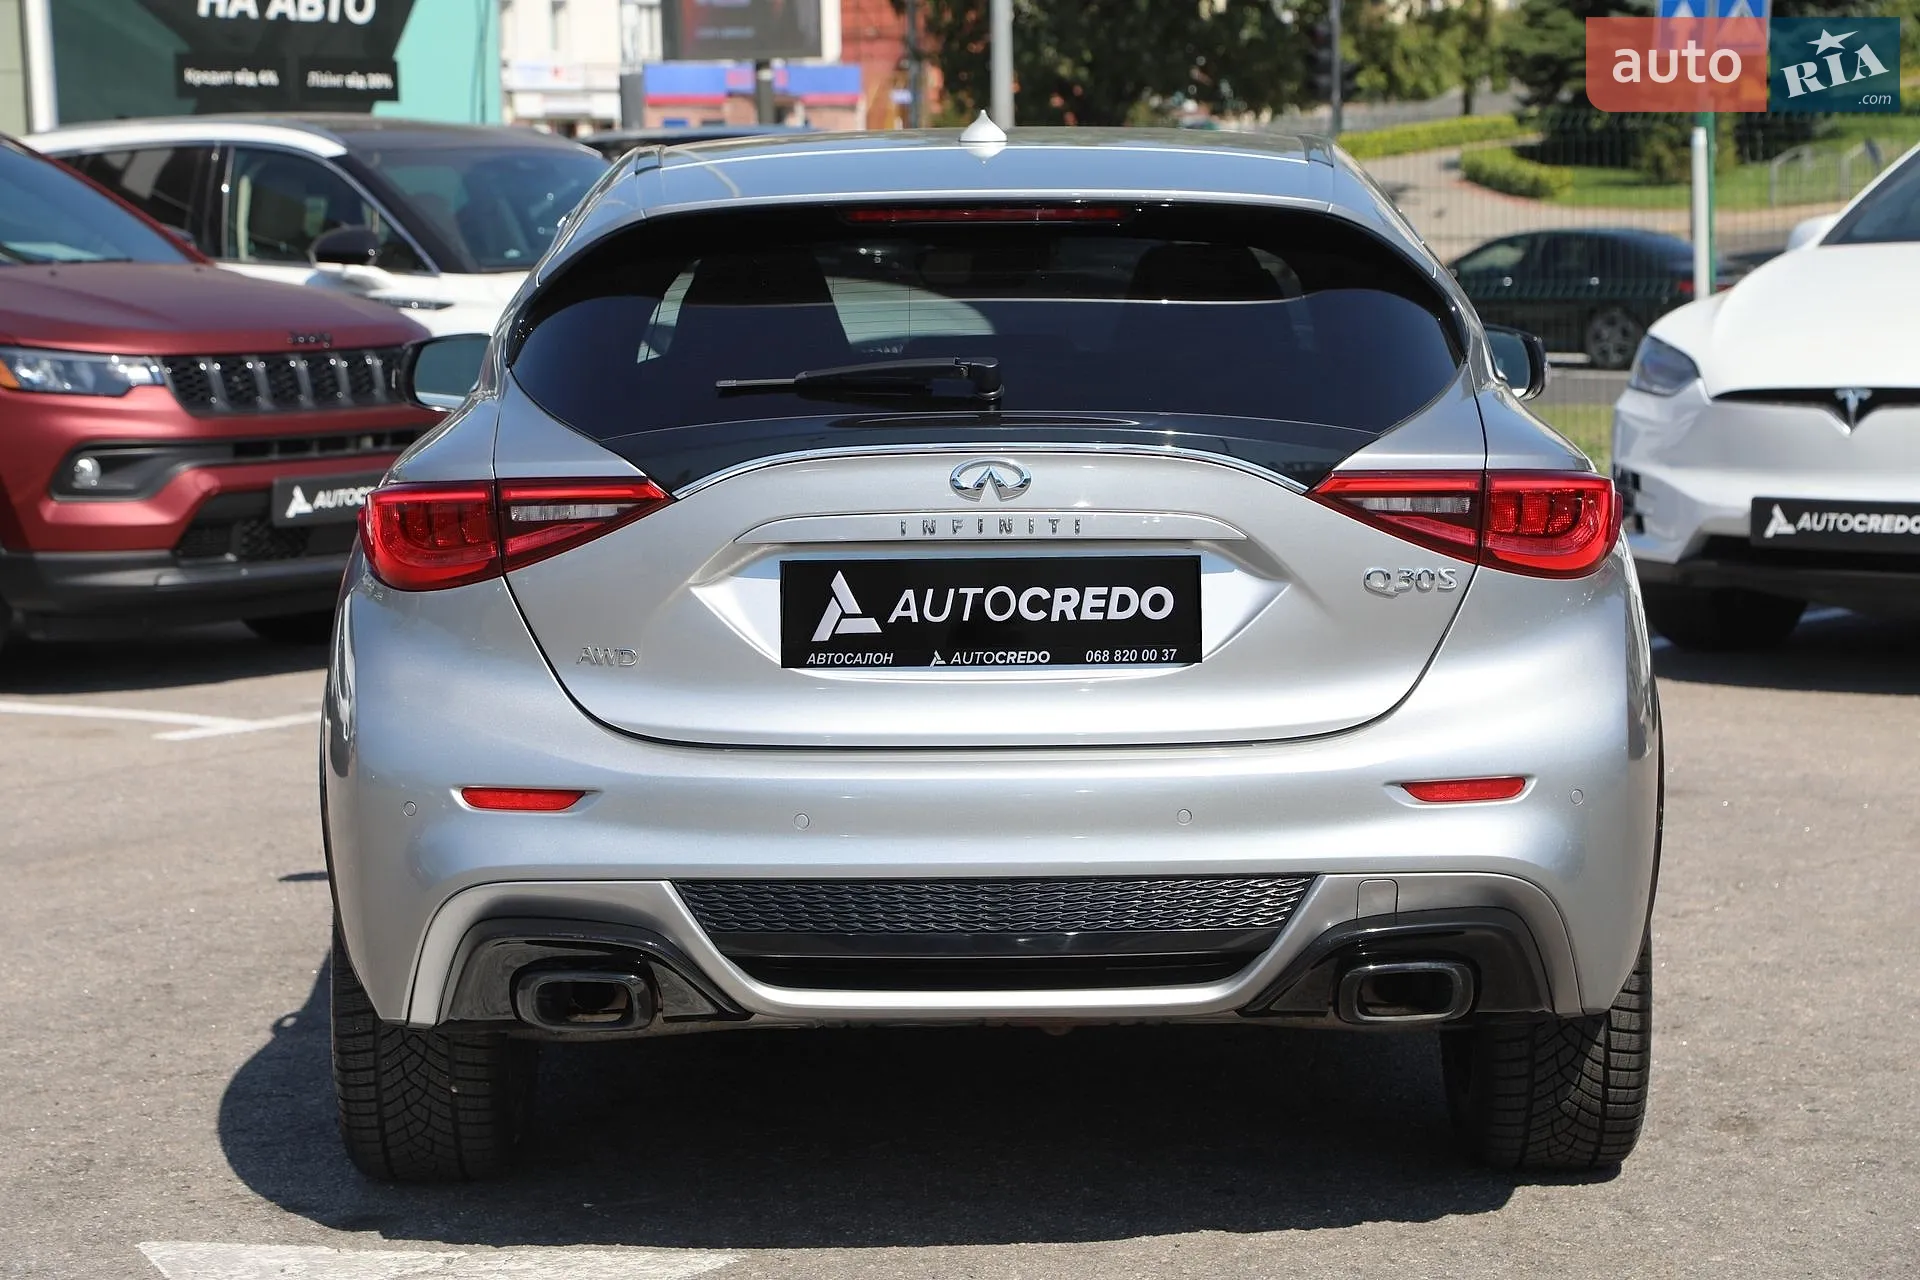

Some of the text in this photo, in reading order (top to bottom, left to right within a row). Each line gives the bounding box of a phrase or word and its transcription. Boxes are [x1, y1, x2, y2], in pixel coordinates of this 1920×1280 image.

[313, 486, 376, 509] AUTOC
[900, 517, 1081, 536] INFINITI
[1364, 567, 1457, 599] Q30S
[888, 585, 1175, 623] AUTOCREDO
[576, 646, 640, 667] AWD
[806, 652, 894, 665] АВТОСАЛОН
[950, 650, 1051, 665] AUTOCREDO
[1085, 648, 1177, 663] 068 820 00 37
